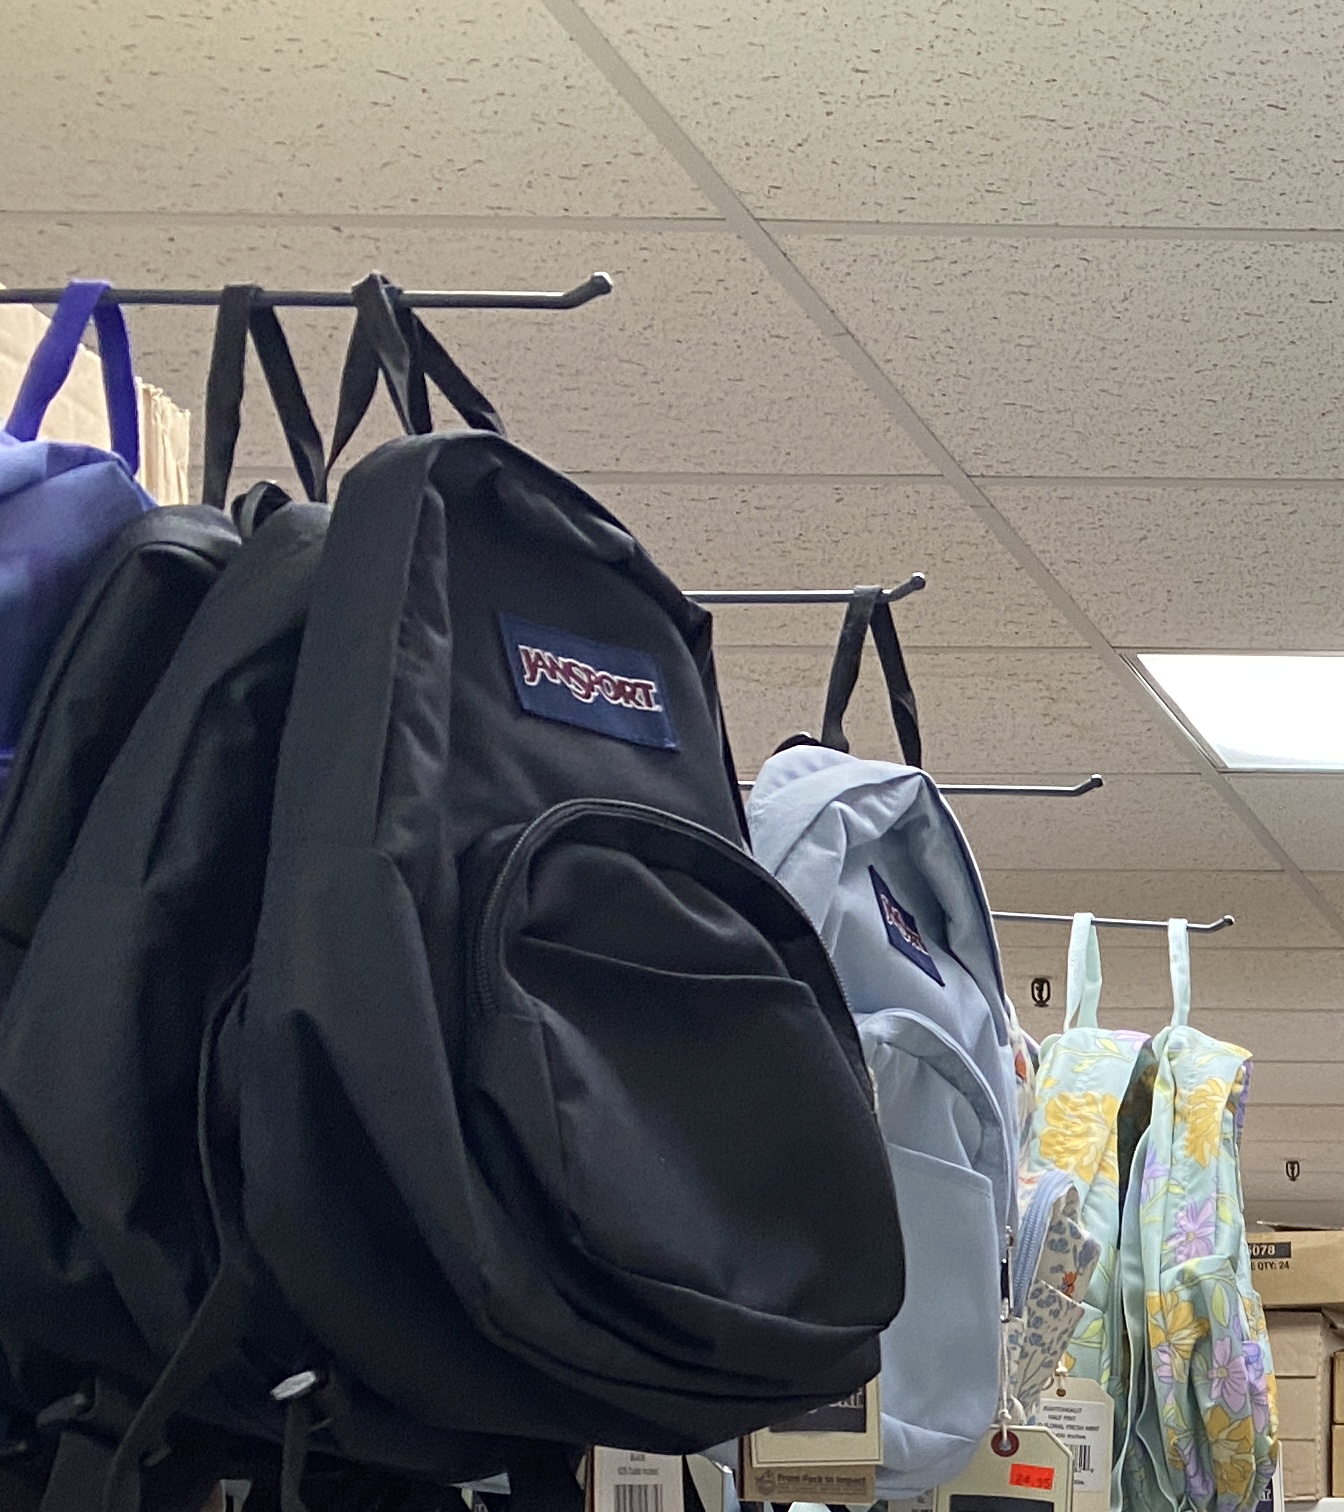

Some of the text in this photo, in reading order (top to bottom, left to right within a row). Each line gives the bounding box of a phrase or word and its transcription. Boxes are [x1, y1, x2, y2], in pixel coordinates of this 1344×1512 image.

[518, 644, 663, 712] JANSPORT
[1257, 1261, 1290, 1271] QTY: 24
